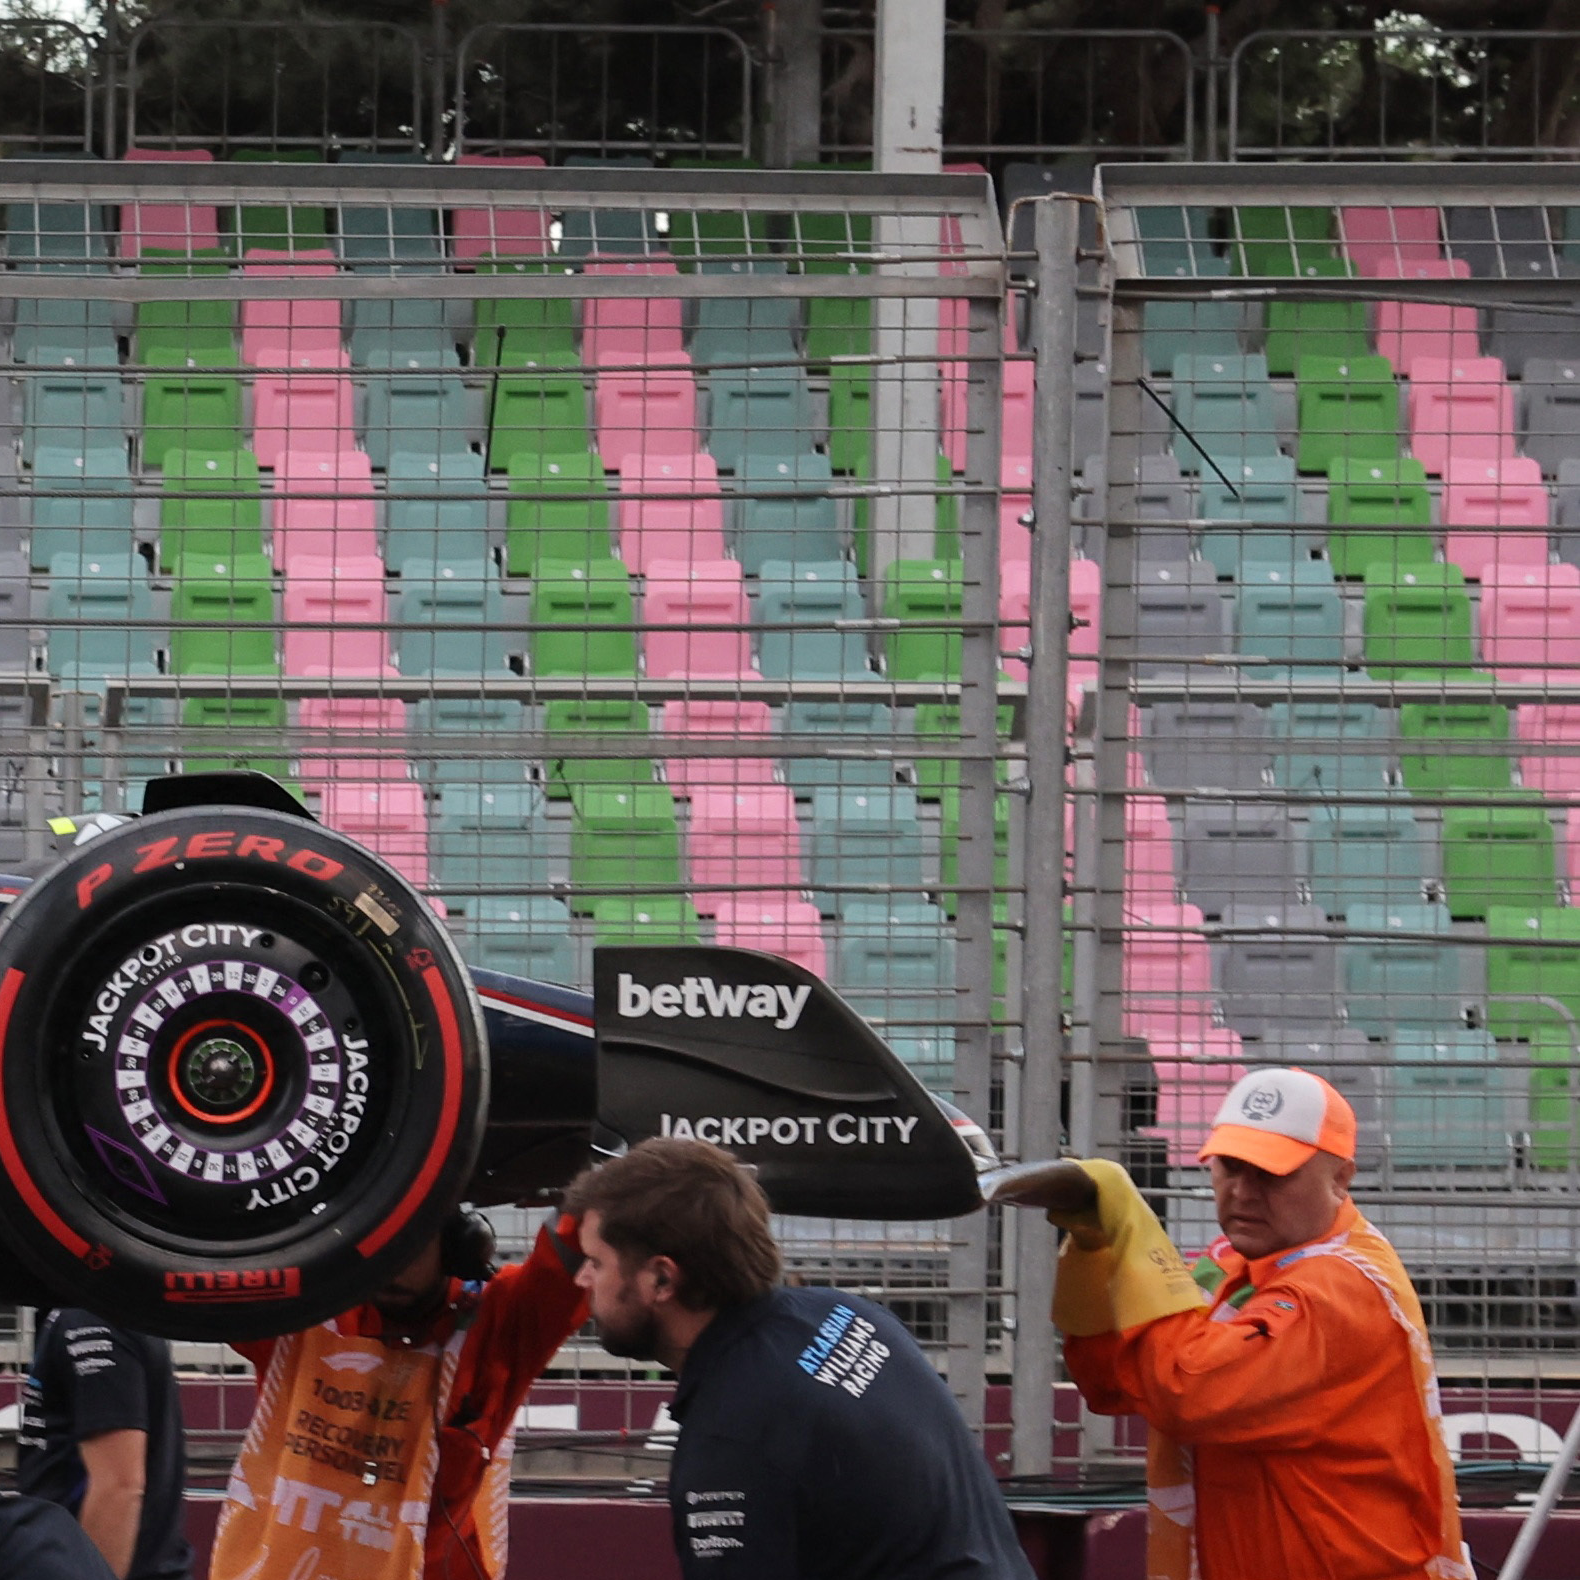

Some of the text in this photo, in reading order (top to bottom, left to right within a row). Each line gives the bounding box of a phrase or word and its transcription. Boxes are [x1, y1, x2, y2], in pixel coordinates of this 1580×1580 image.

[76, 831, 345, 909] P ZERO
[81, 923, 264, 1053] JACKPOT CITY
[617, 973, 812, 1030] betway
[245, 1033, 369, 1211] JACKPOT CITY
[660, 1112, 919, 1145] JACKPOT CITY
[165, 1266, 301, 1303] PIRELLI
[796, 1303, 856, 1376] ATLASSIAN
[813, 1316, 877, 1387] WILLIAMS
[840, 1339, 891, 1399] RACING
